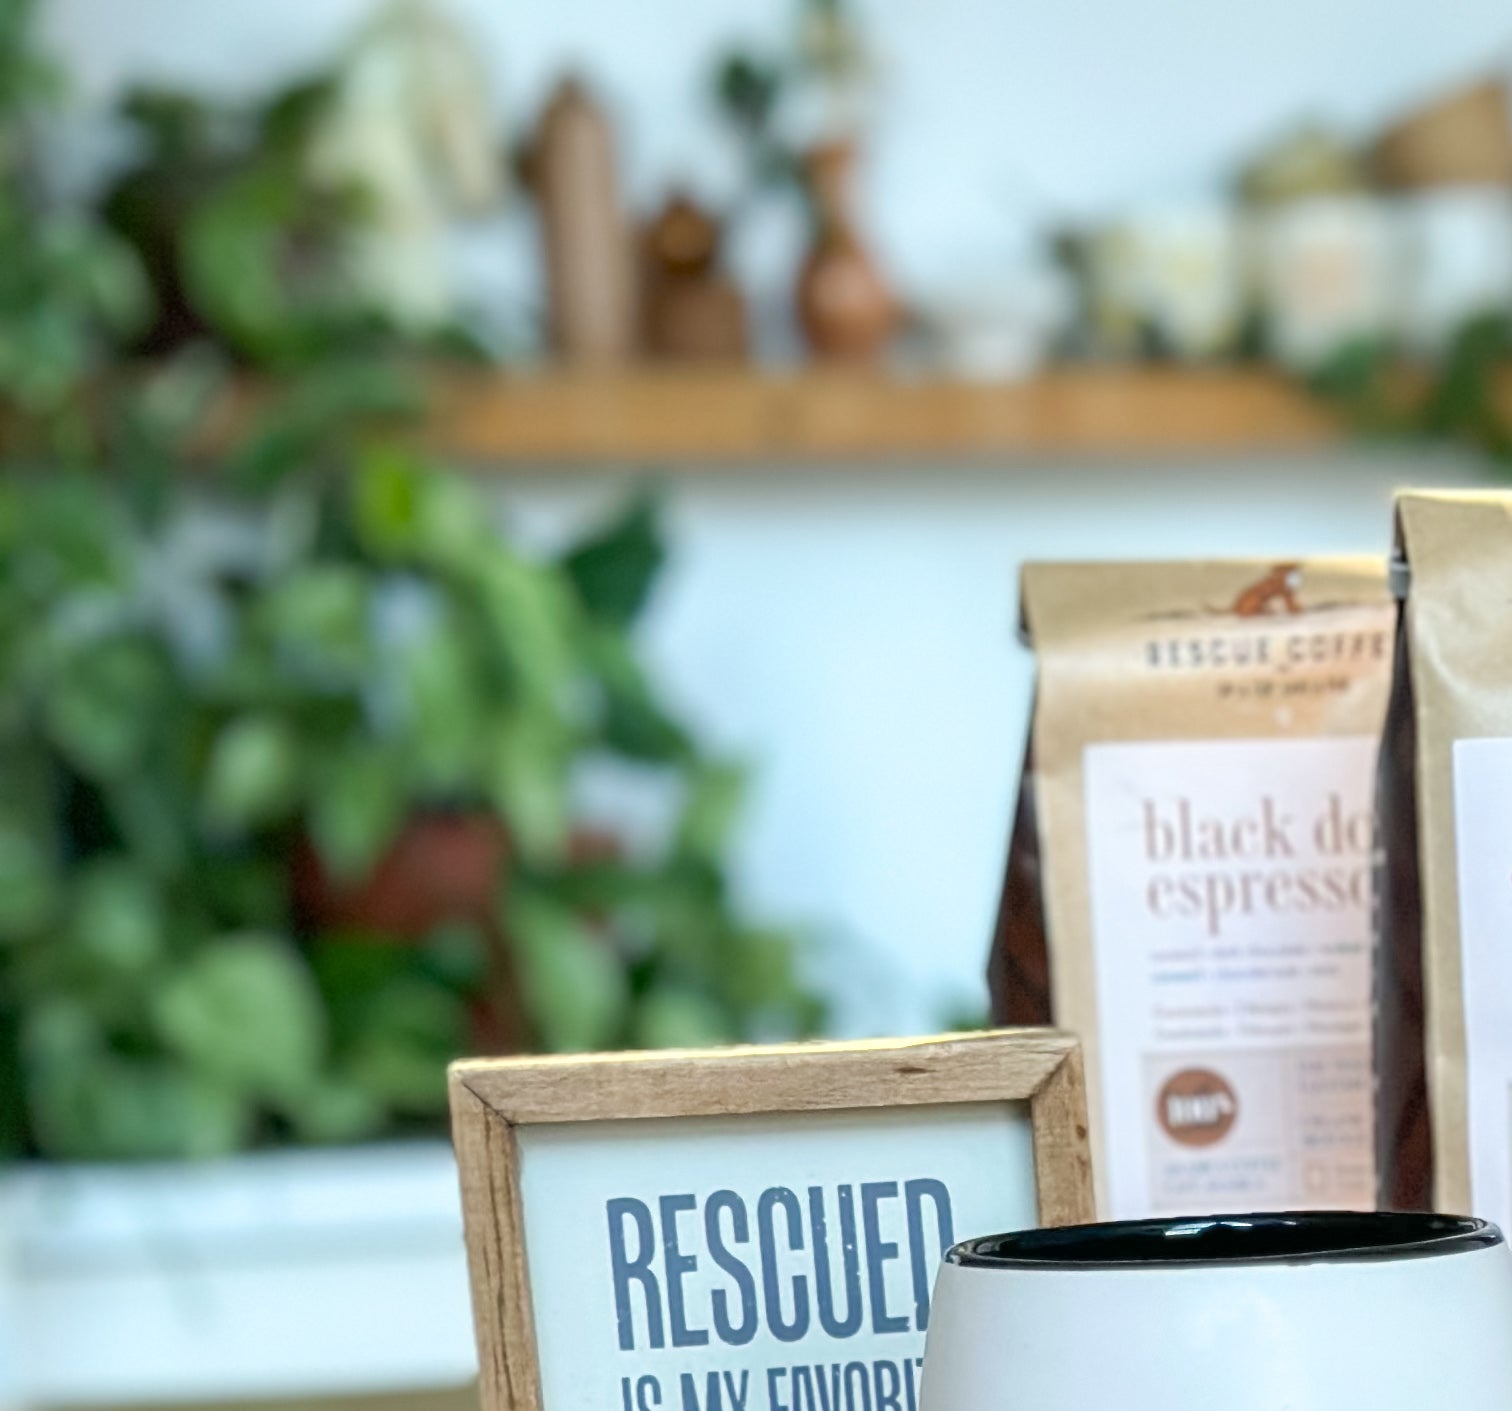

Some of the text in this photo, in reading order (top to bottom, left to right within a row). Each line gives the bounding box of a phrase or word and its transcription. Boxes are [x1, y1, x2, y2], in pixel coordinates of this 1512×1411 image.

[1145, 631, 1389, 668] RESCUE COFFE
[1141, 792, 1372, 863] black do
